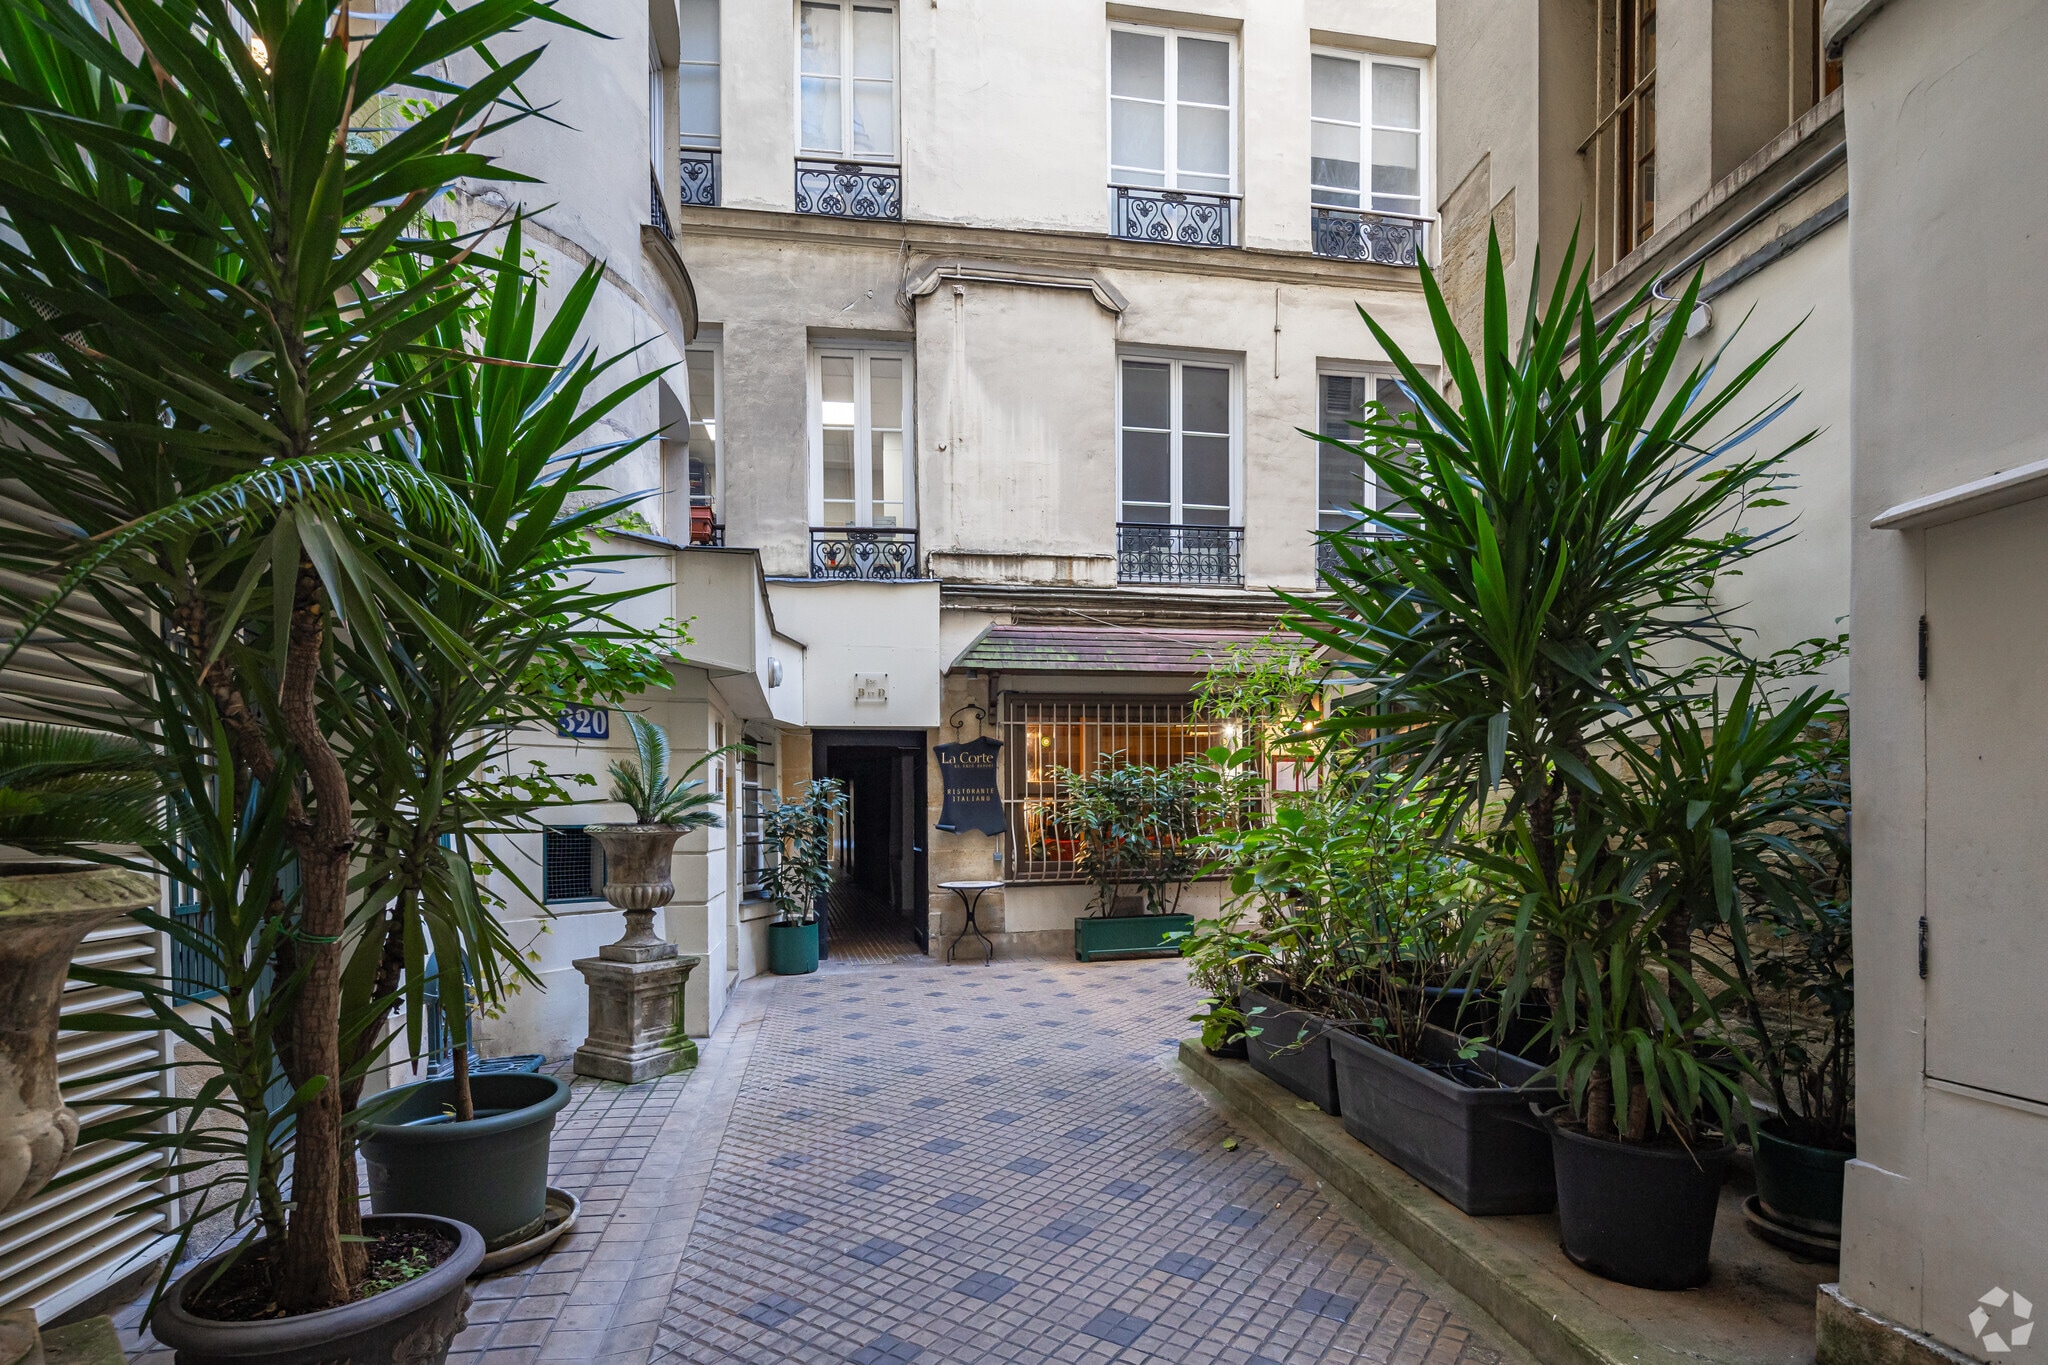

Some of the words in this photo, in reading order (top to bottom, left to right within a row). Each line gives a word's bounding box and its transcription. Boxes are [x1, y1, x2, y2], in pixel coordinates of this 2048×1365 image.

[858, 688, 865, 696] B
[878, 688, 885, 696] D
[561, 708, 607, 734] 320
[942, 752, 956, 764] La
[959, 751, 994, 764] Corte
